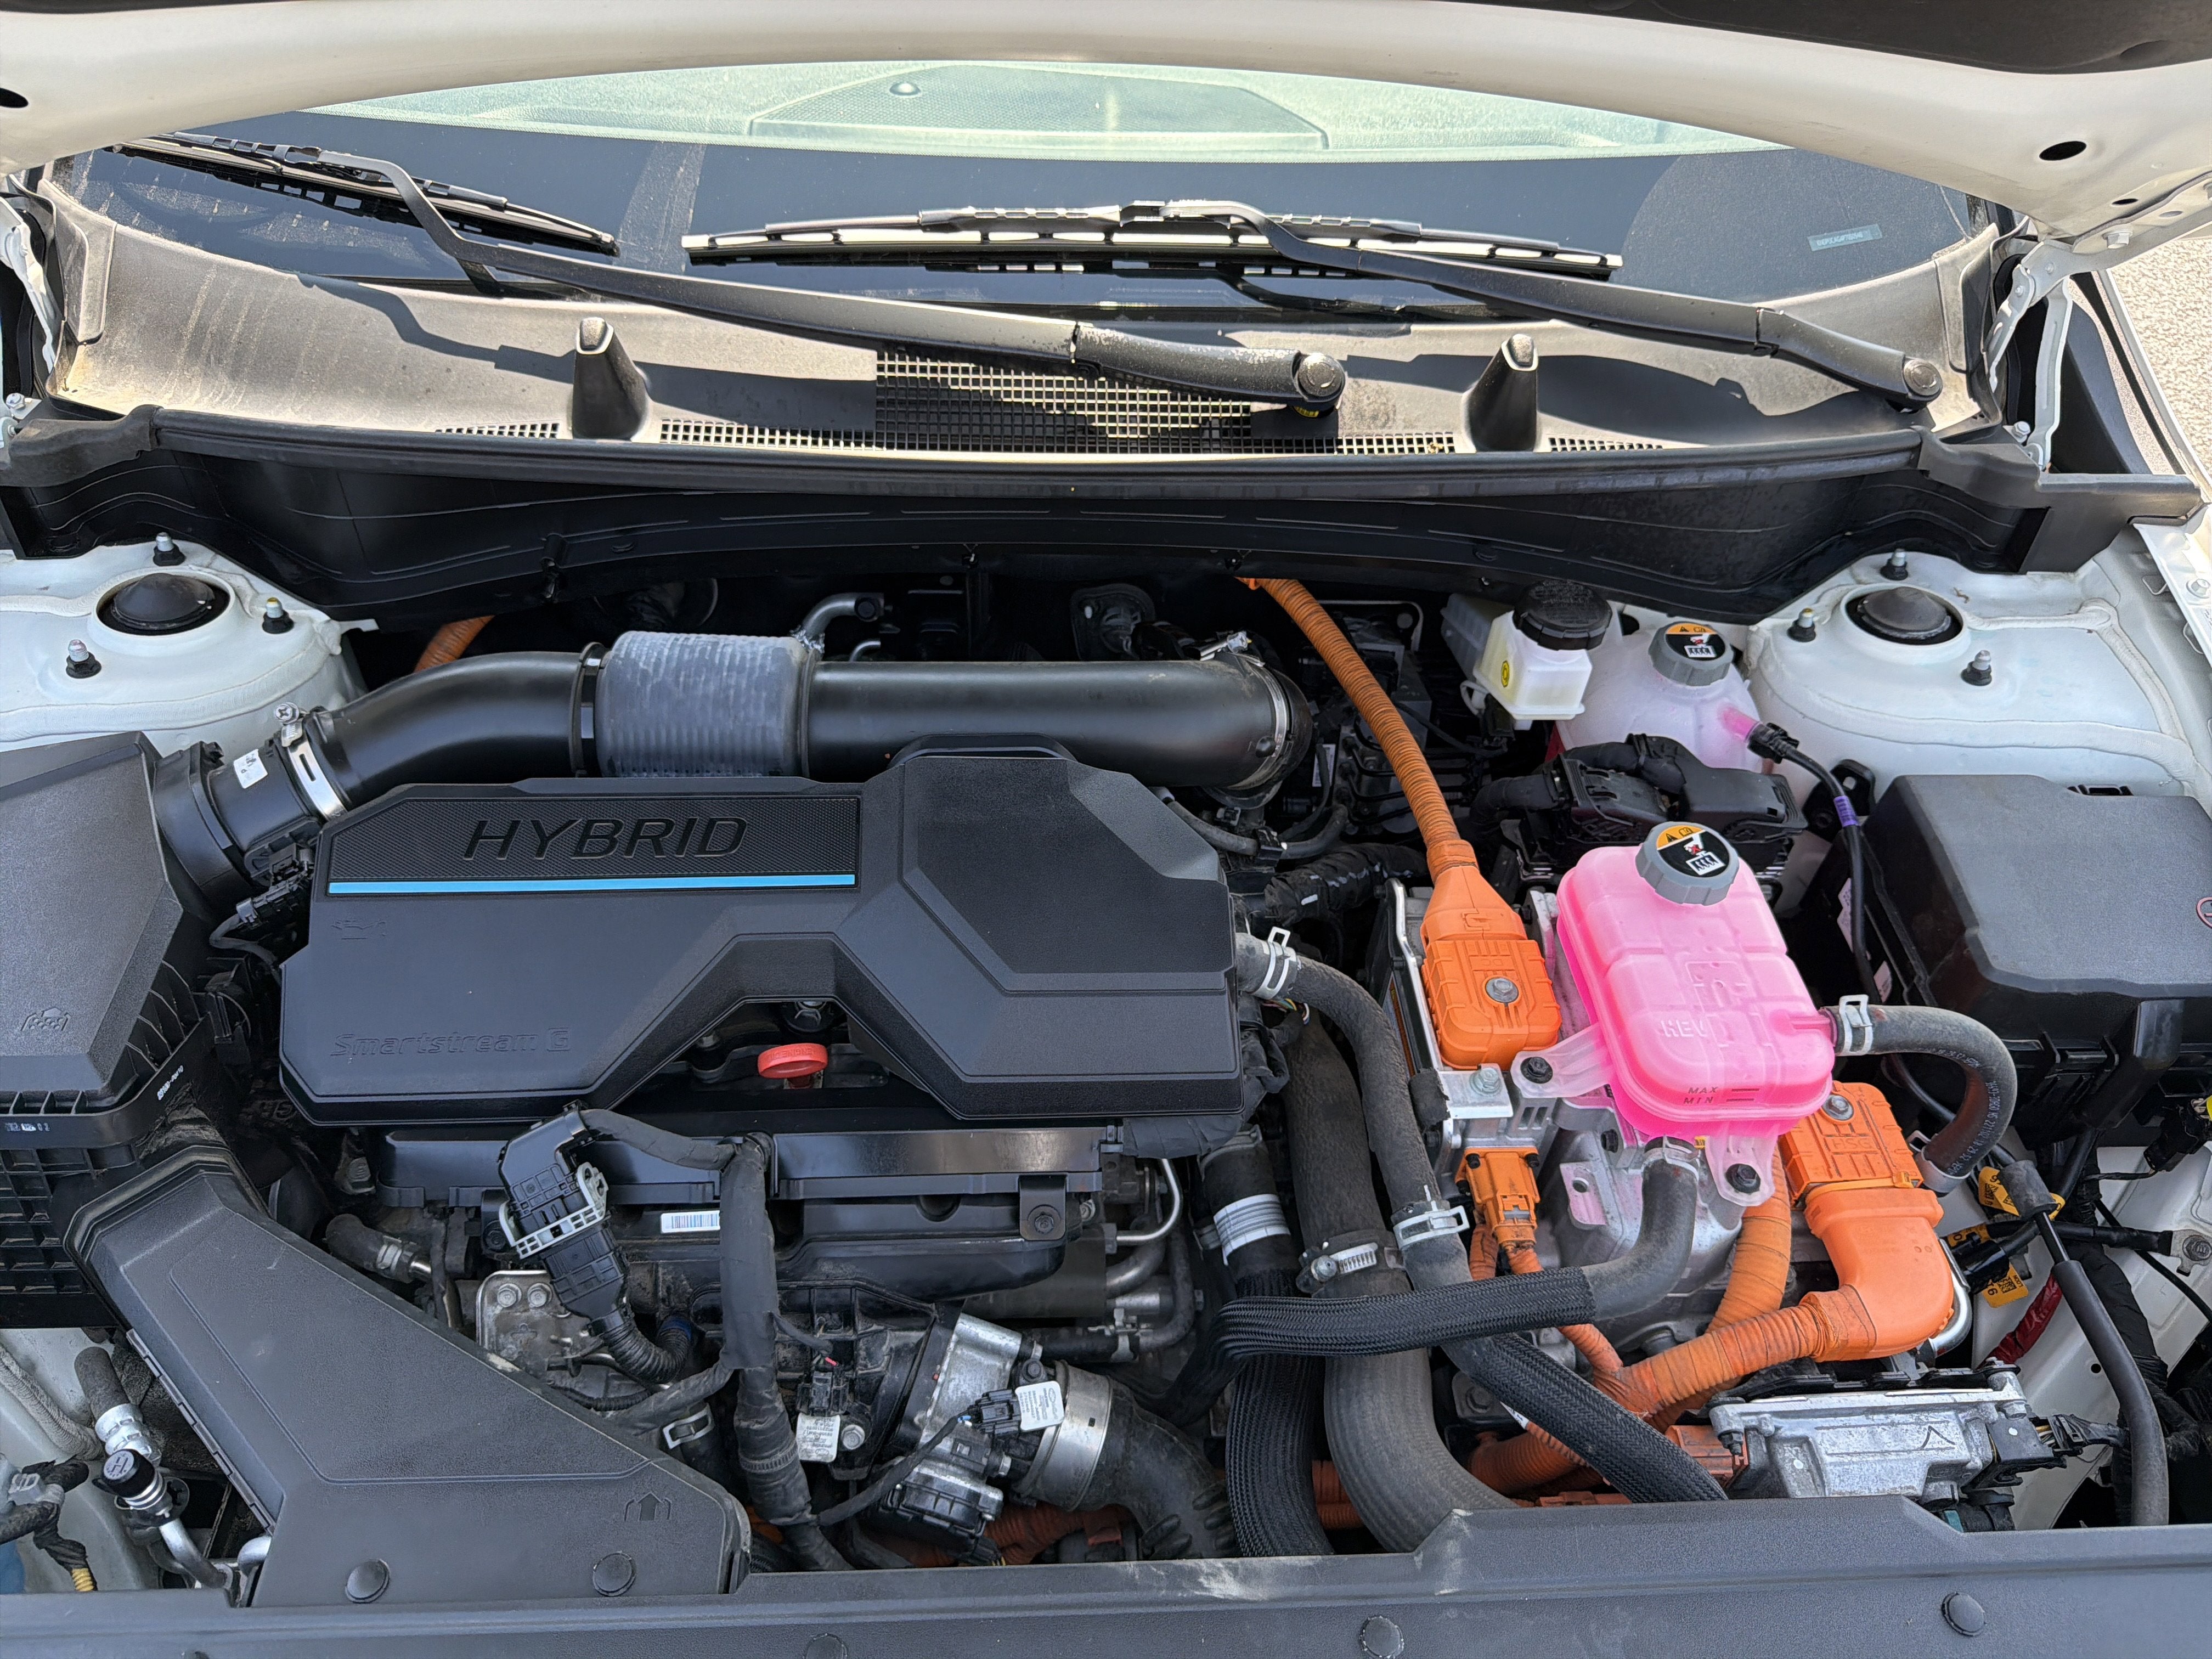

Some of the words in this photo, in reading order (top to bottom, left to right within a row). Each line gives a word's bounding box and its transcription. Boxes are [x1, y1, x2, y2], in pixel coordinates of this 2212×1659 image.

[463, 817, 748, 860] HYBRID
[1661, 1019, 1708, 1037] HEV
[330, 1032, 539, 1057] Smartstream
[1688, 1086, 1718, 1094] MAX
[1683, 1096, 1713, 1104] MIN
[1832, 1137, 1874, 1150] HSG
